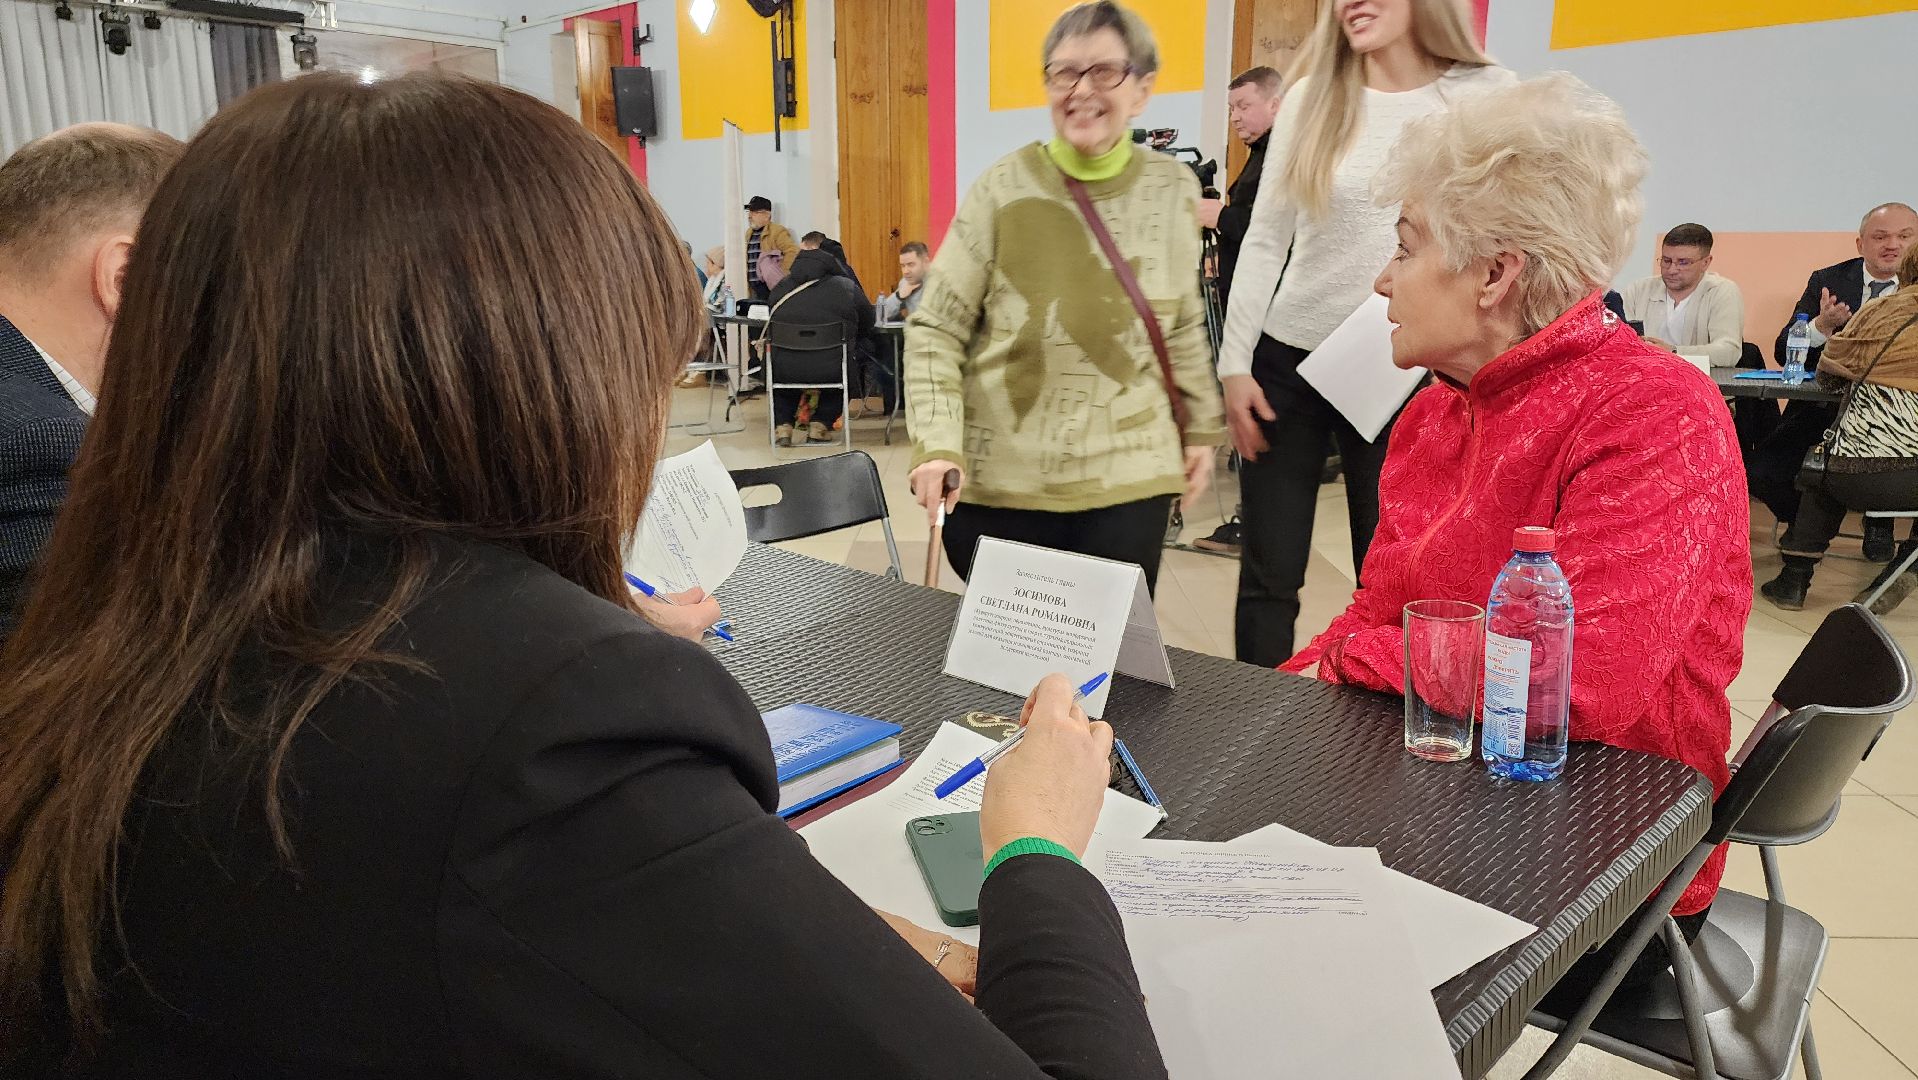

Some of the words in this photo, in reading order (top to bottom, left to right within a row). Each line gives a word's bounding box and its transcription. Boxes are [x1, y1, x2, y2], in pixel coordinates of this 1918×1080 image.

[1013, 586, 1067, 608] ЗОСИМОВА
[980, 595, 1030, 615] СВЕТЛАНА
[1030, 606, 1097, 632] РОМАНОВНА
